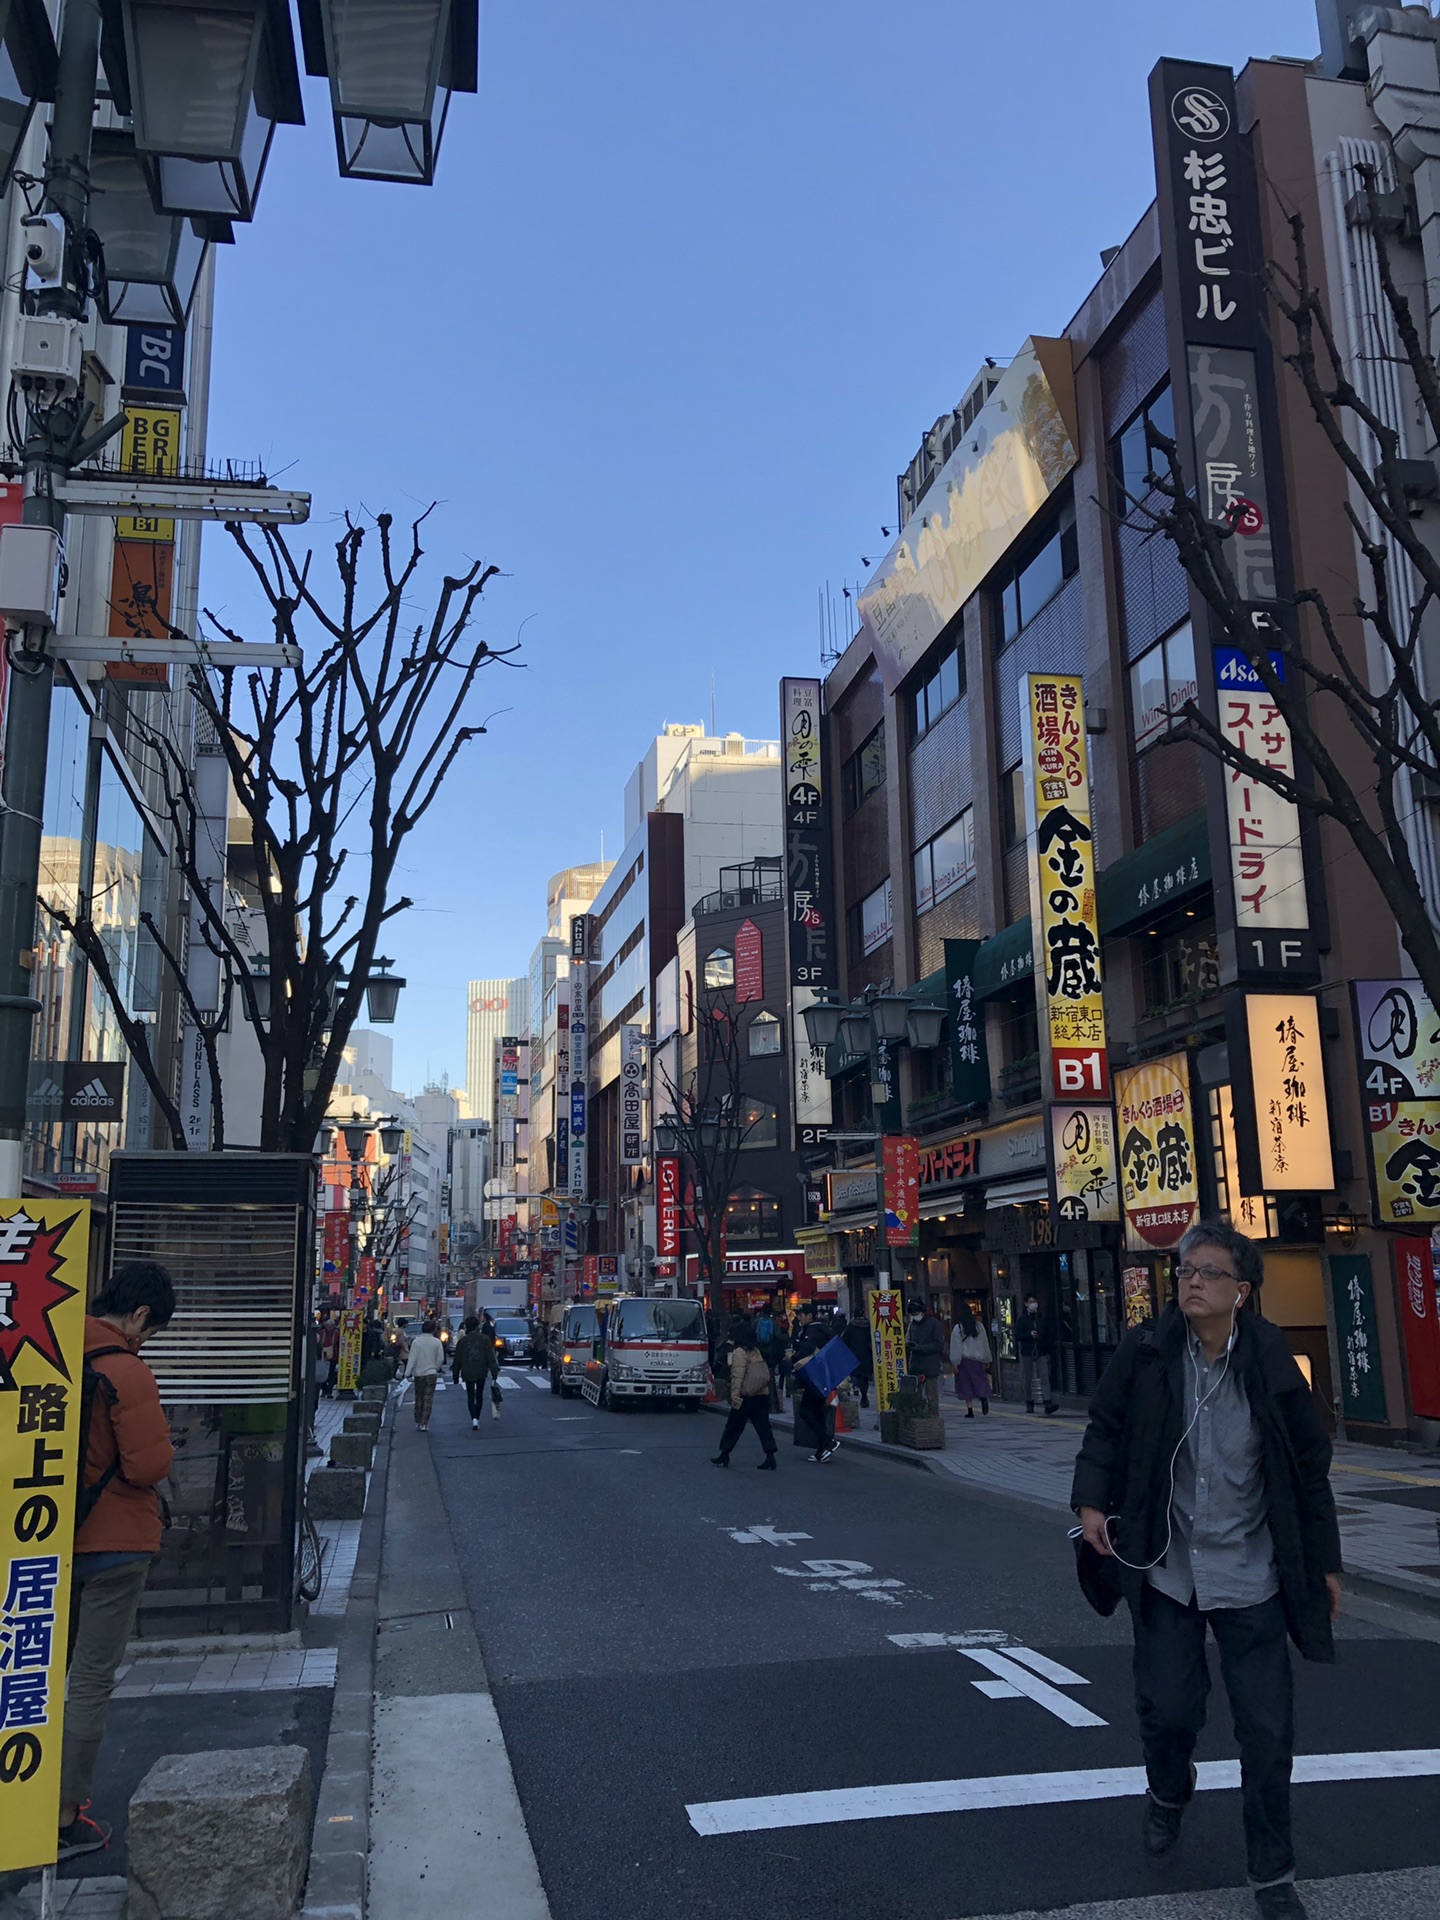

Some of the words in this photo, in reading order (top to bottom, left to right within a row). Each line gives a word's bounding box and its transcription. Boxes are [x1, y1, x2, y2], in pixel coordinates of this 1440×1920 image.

[1183, 149, 1237, 321] 杉忠ビル
[1244, 393, 1257, 478] 手作り料理と地ワイン
[135, 517, 157, 531] B1
[1220, 657, 1277, 683] Asai
[1034, 683, 1060, 746] 酒場
[1142, 701, 1167, 728] Wine
[1060, 684, 1083, 787] きんくら
[1041, 749, 1057, 757] KIN
[1041, 762, 1063, 771] KURA
[793, 786, 818, 805] 4F
[793, 811, 818, 824] 4F
[919, 885, 932, 900] Wine
[934, 872, 951, 891] Dining
[1039, 805, 1103, 1000] 金の蔵
[797, 967, 822, 981] 3F
[953, 975, 980, 1064] 椿屋珈琲
[1050, 1006, 1104, 1023] 新宿東口
[1053, 1023, 1102, 1042] 総本店
[192, 1033, 204, 1108] SUNGLASS
[1058, 1052, 1102, 1091] B1
[1275, 1015, 1310, 1128] 椿屋珈琲
[1366, 1066, 1403, 1095] 4F
[70, 1096, 115, 1106] adidas
[624, 1081, 640, 1130] 高田屋
[1121, 1093, 1174, 1125] きんくら酒場
[1368, 1102, 1393, 1123] B1
[189, 1115, 202, 1124] 2F
[189, 1127, 201, 1135] 1F
[626, 1135, 638, 1144] 6F
[803, 1129, 828, 1144] 2F
[1268, 1098, 1290, 1174] 新宿茶寮
[626, 1147, 638, 1157] 7F
[1062, 1110, 1116, 1209] 月の雫
[1122, 1121, 1193, 1192] 金の蔵
[662, 1160, 675, 1251] LOTTERIA
[1060, 1200, 1085, 1220] 4F
[1136, 1208, 1189, 1228] 新宿東口総本店
[1347, 1275, 1371, 1373] 椿屋珈琲
[0, 1382, 69, 1784] 路上の居酒屋の
